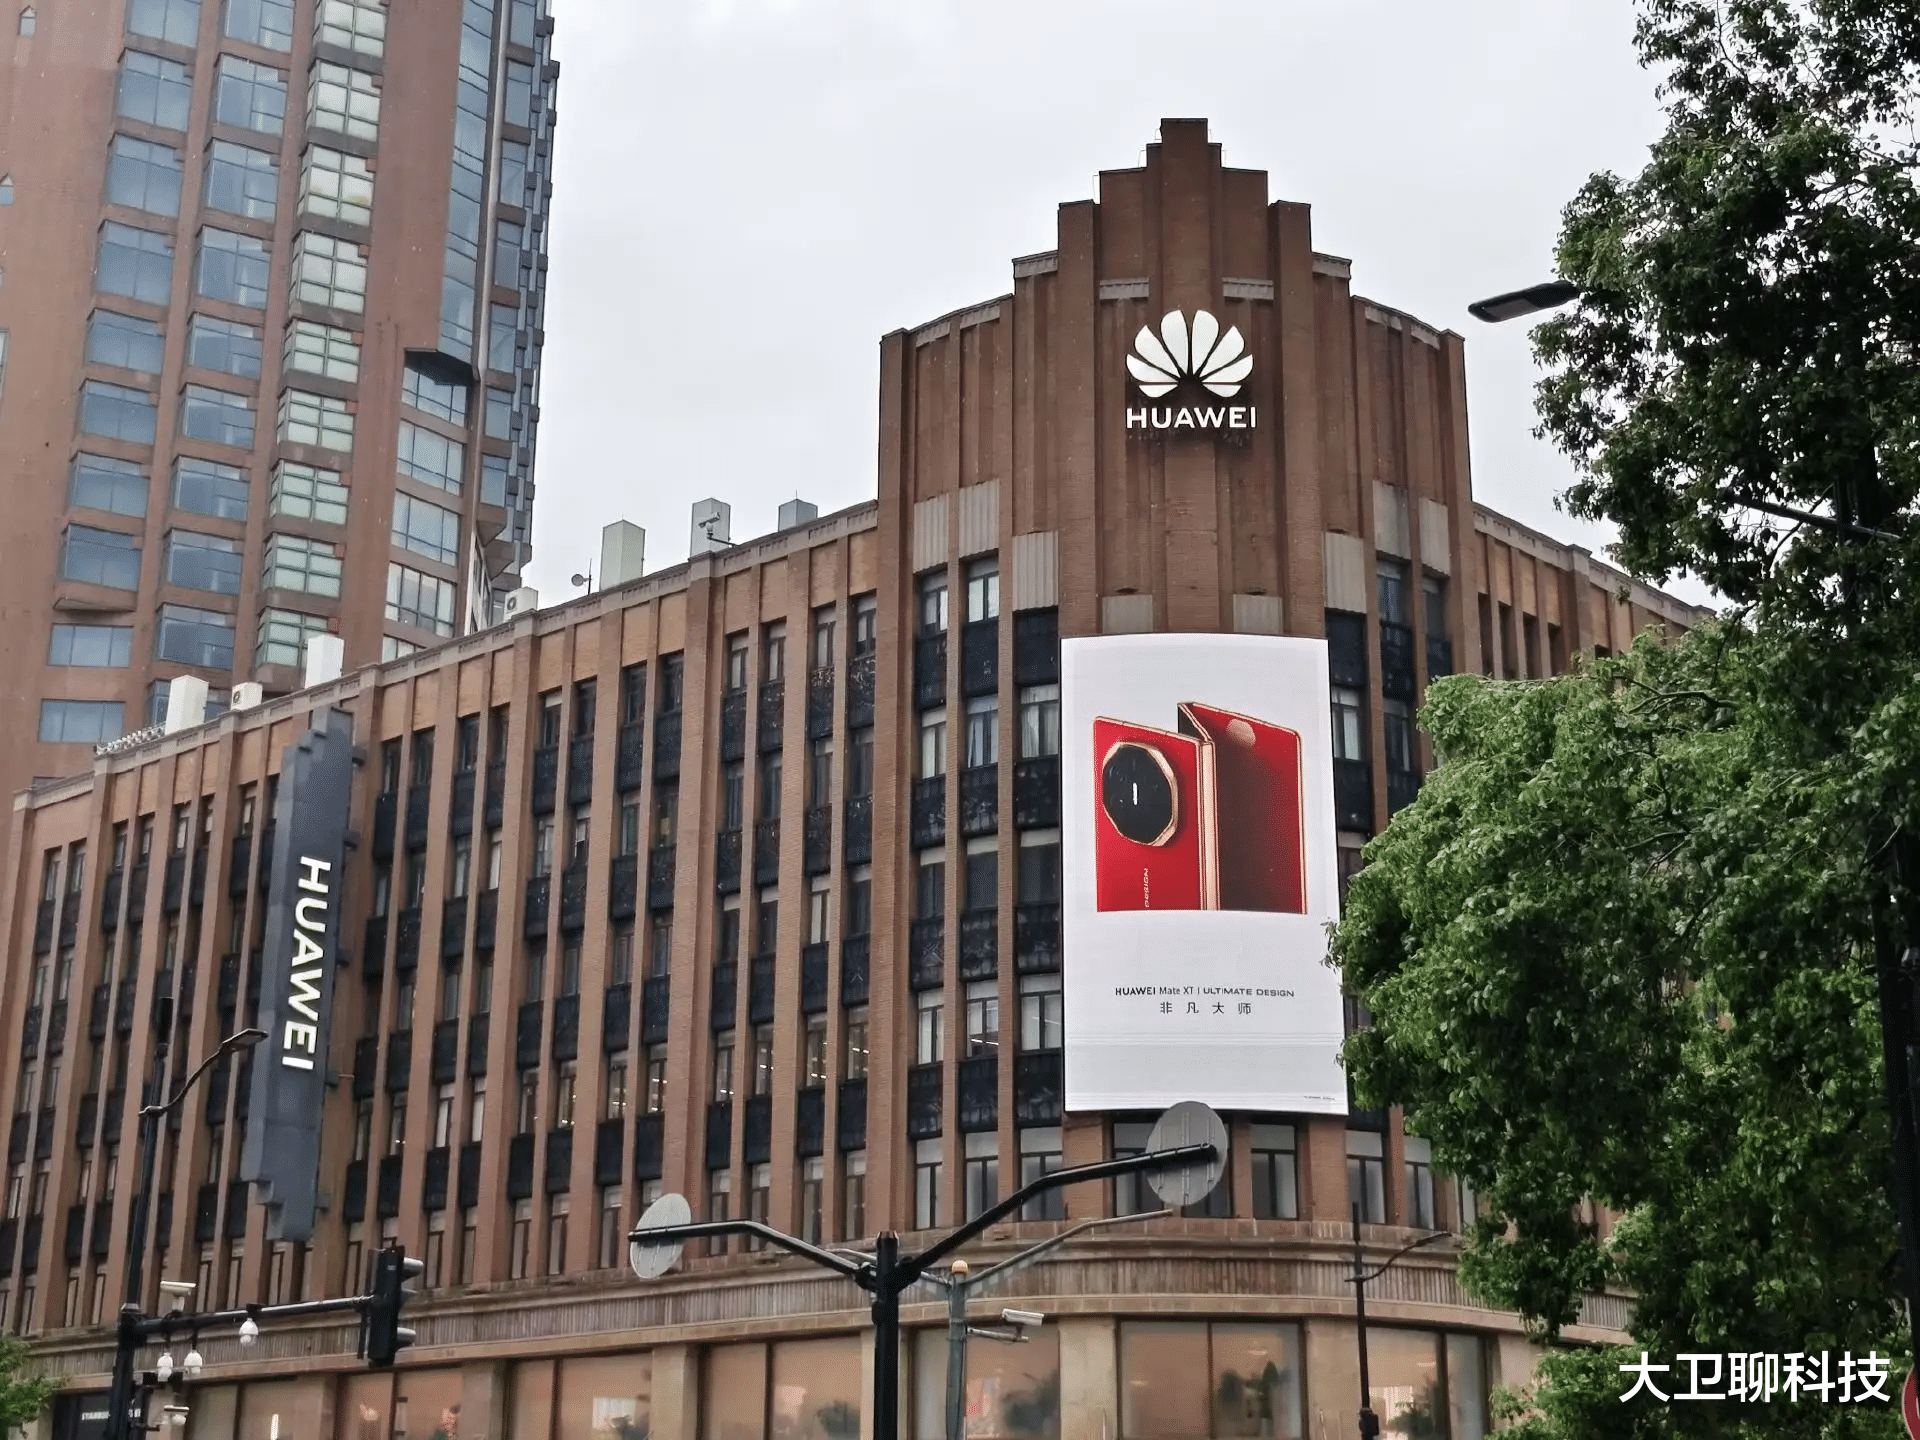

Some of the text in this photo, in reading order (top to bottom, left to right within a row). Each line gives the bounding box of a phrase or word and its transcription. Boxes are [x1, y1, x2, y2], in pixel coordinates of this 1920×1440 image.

[1126, 406, 1256, 429] HUAWEI
[282, 855, 331, 1070] HUAWEI
[1115, 986, 1156, 996] HUAWEI
[1159, 986, 1180, 995] Mate
[1183, 986, 1194, 995] XT
[1203, 987, 1253, 996] ULTIMATE
[1255, 988, 1295, 998] DESIGN
[1160, 1001, 1252, 1015] 非凡大师
